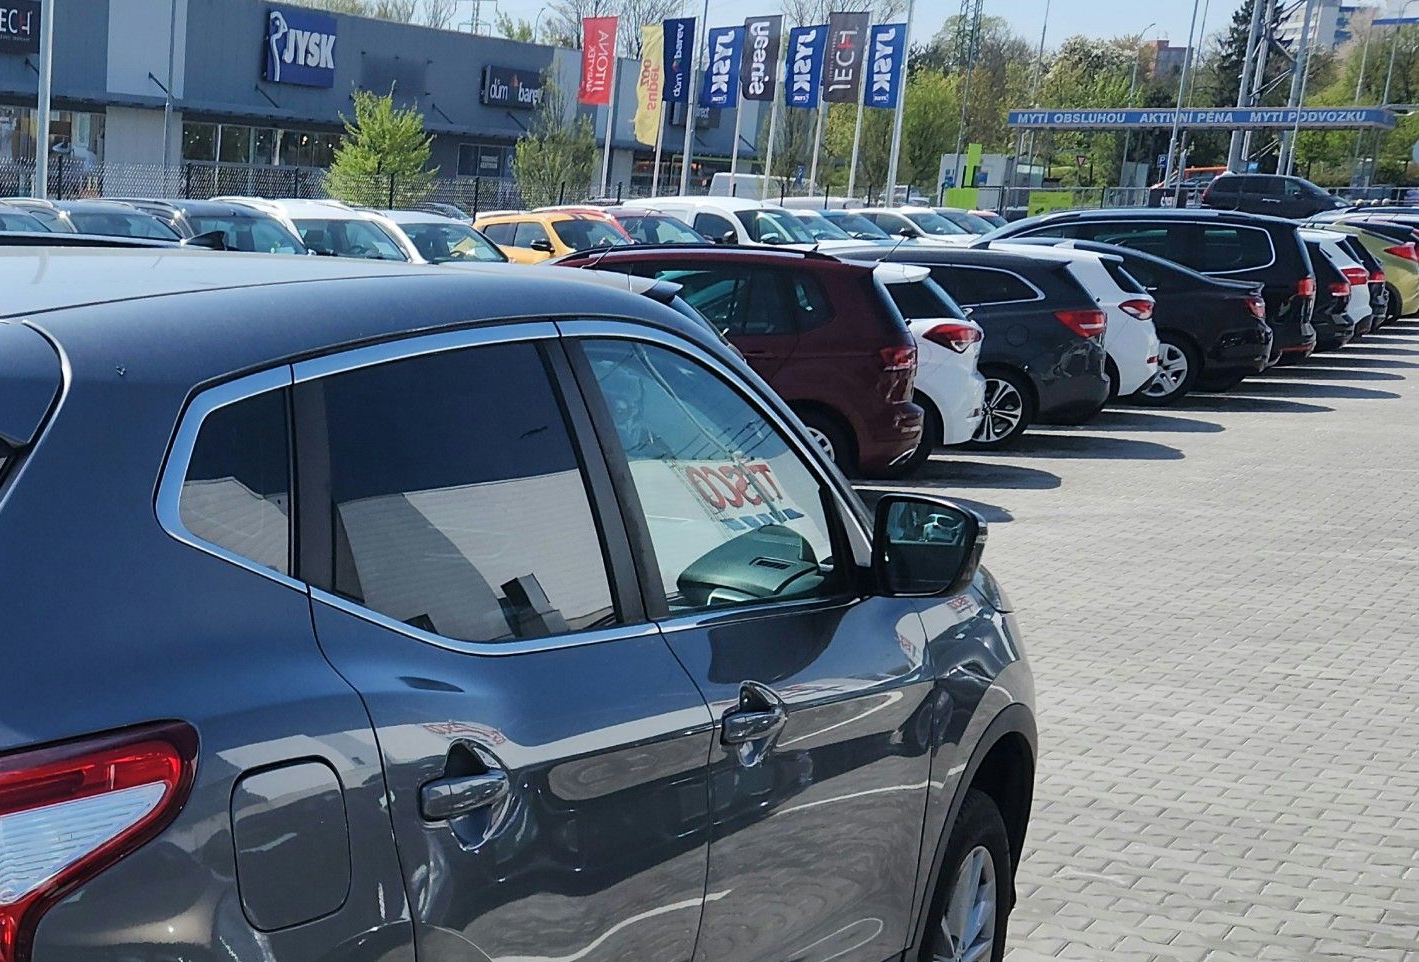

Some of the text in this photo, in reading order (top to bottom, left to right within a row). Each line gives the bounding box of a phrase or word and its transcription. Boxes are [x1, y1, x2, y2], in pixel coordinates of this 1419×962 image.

[282, 28, 336, 69] JYSK
[674, 23, 685, 59] barev
[1017, 111, 1048, 124] MYTÍ
[1053, 112, 1126, 124] OBSLUHOU
